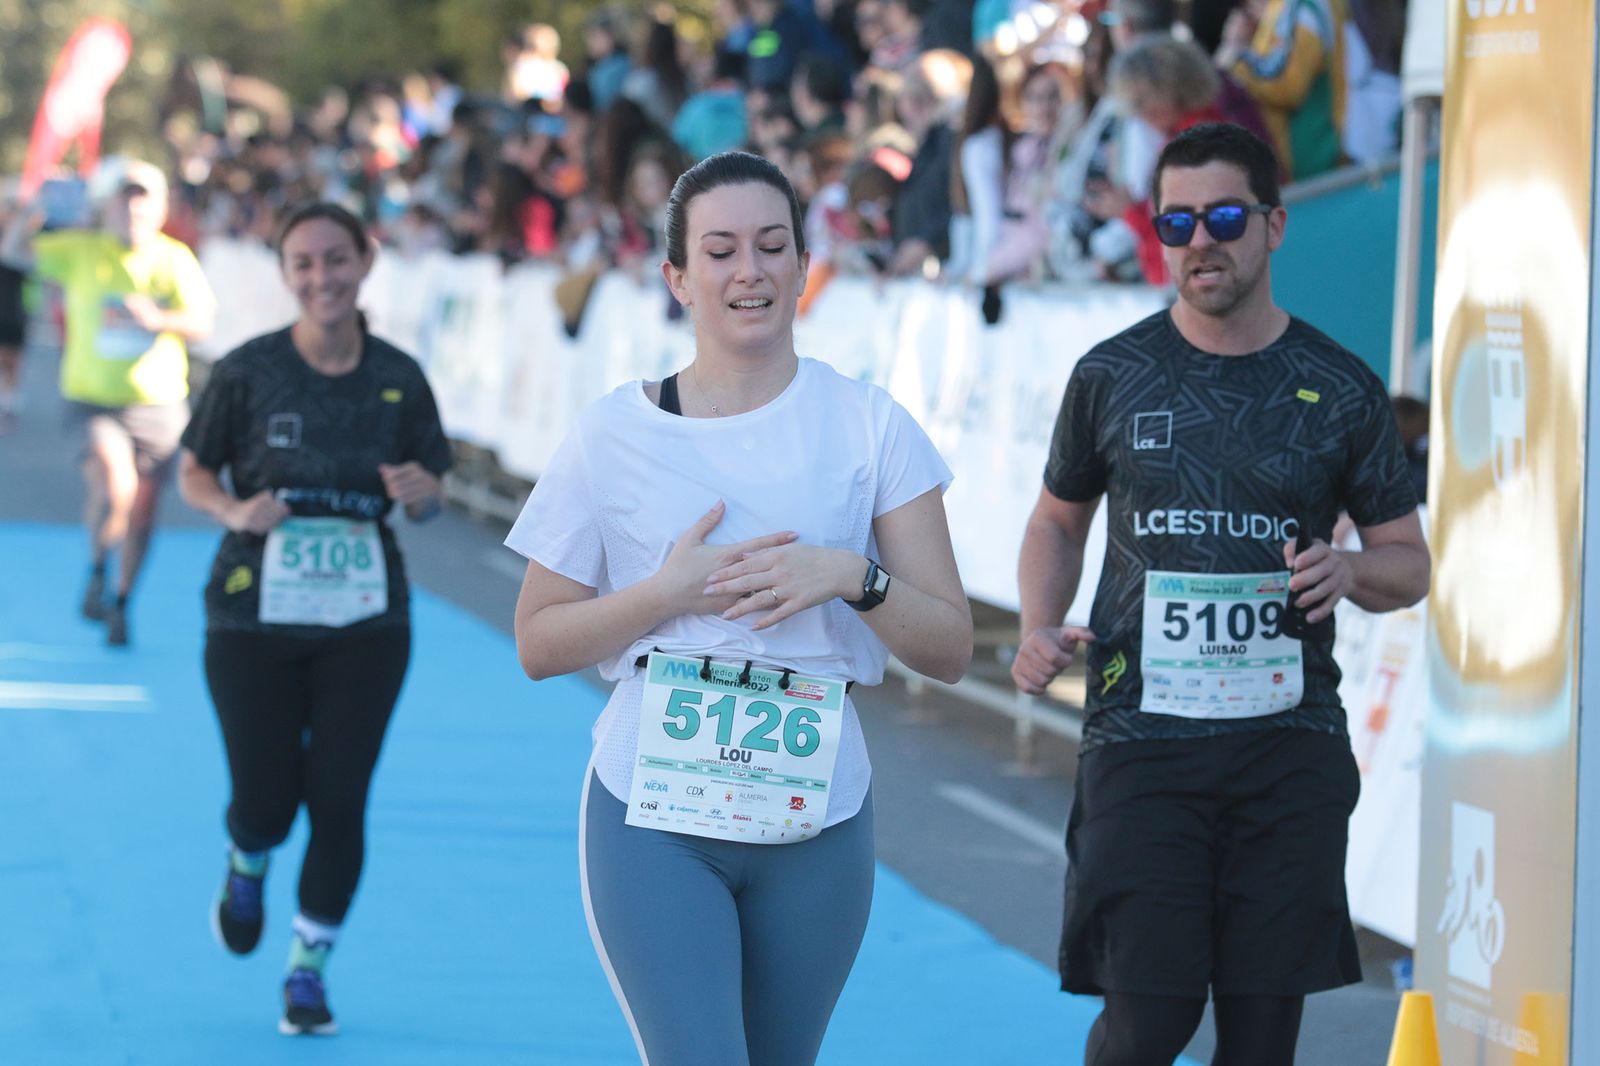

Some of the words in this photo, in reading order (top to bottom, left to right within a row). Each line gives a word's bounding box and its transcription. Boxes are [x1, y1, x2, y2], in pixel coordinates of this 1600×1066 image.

[1133, 438, 1156, 450] LCE
[1133, 509, 1300, 542] LCESTUDIO
[280, 538, 373, 571] 5108
[1162, 601, 1286, 642] 5109
[1199, 644, 1247, 655] LUISAO
[663, 688, 822, 758] 5126
[719, 747, 753, 763] LOU
[695, 757, 721, 766] LOURDES
[722, 759, 741, 769] LÓPEZ
[741, 763, 752, 771] DEL
[753, 765, 774, 773] CAMPO
[643, 781, 669, 792] NEXA
[685, 785, 706, 796] CDX
[739, 792, 768, 802] ALMERÍA
[640, 801, 658, 811] CASI
